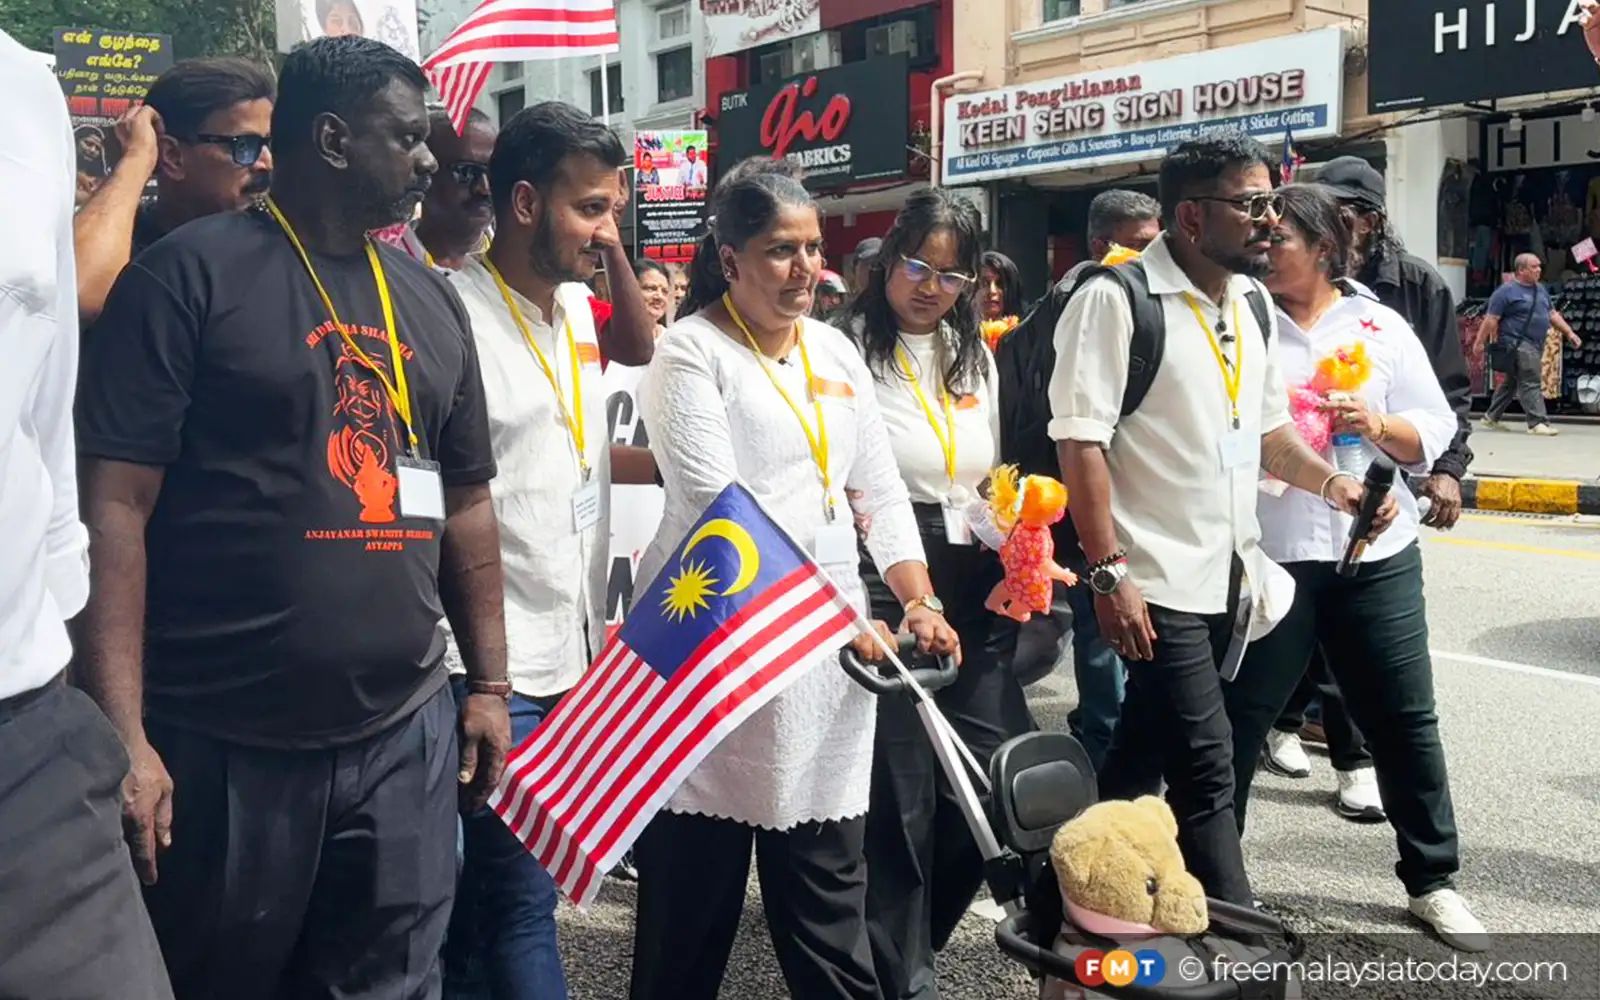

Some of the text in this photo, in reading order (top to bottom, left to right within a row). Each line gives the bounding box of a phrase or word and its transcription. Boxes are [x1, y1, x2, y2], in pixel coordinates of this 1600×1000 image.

[63, 30, 160, 53] என் குழந்தை
[86, 53, 142, 69] எங்கே?
[721, 92, 749, 112] BUTIK
[957, 74, 1142, 120] Kedai Pengiklanan
[960, 69, 1304, 147] KEEN SENG SIGN HOUSE
[760, 76, 852, 160] gio
